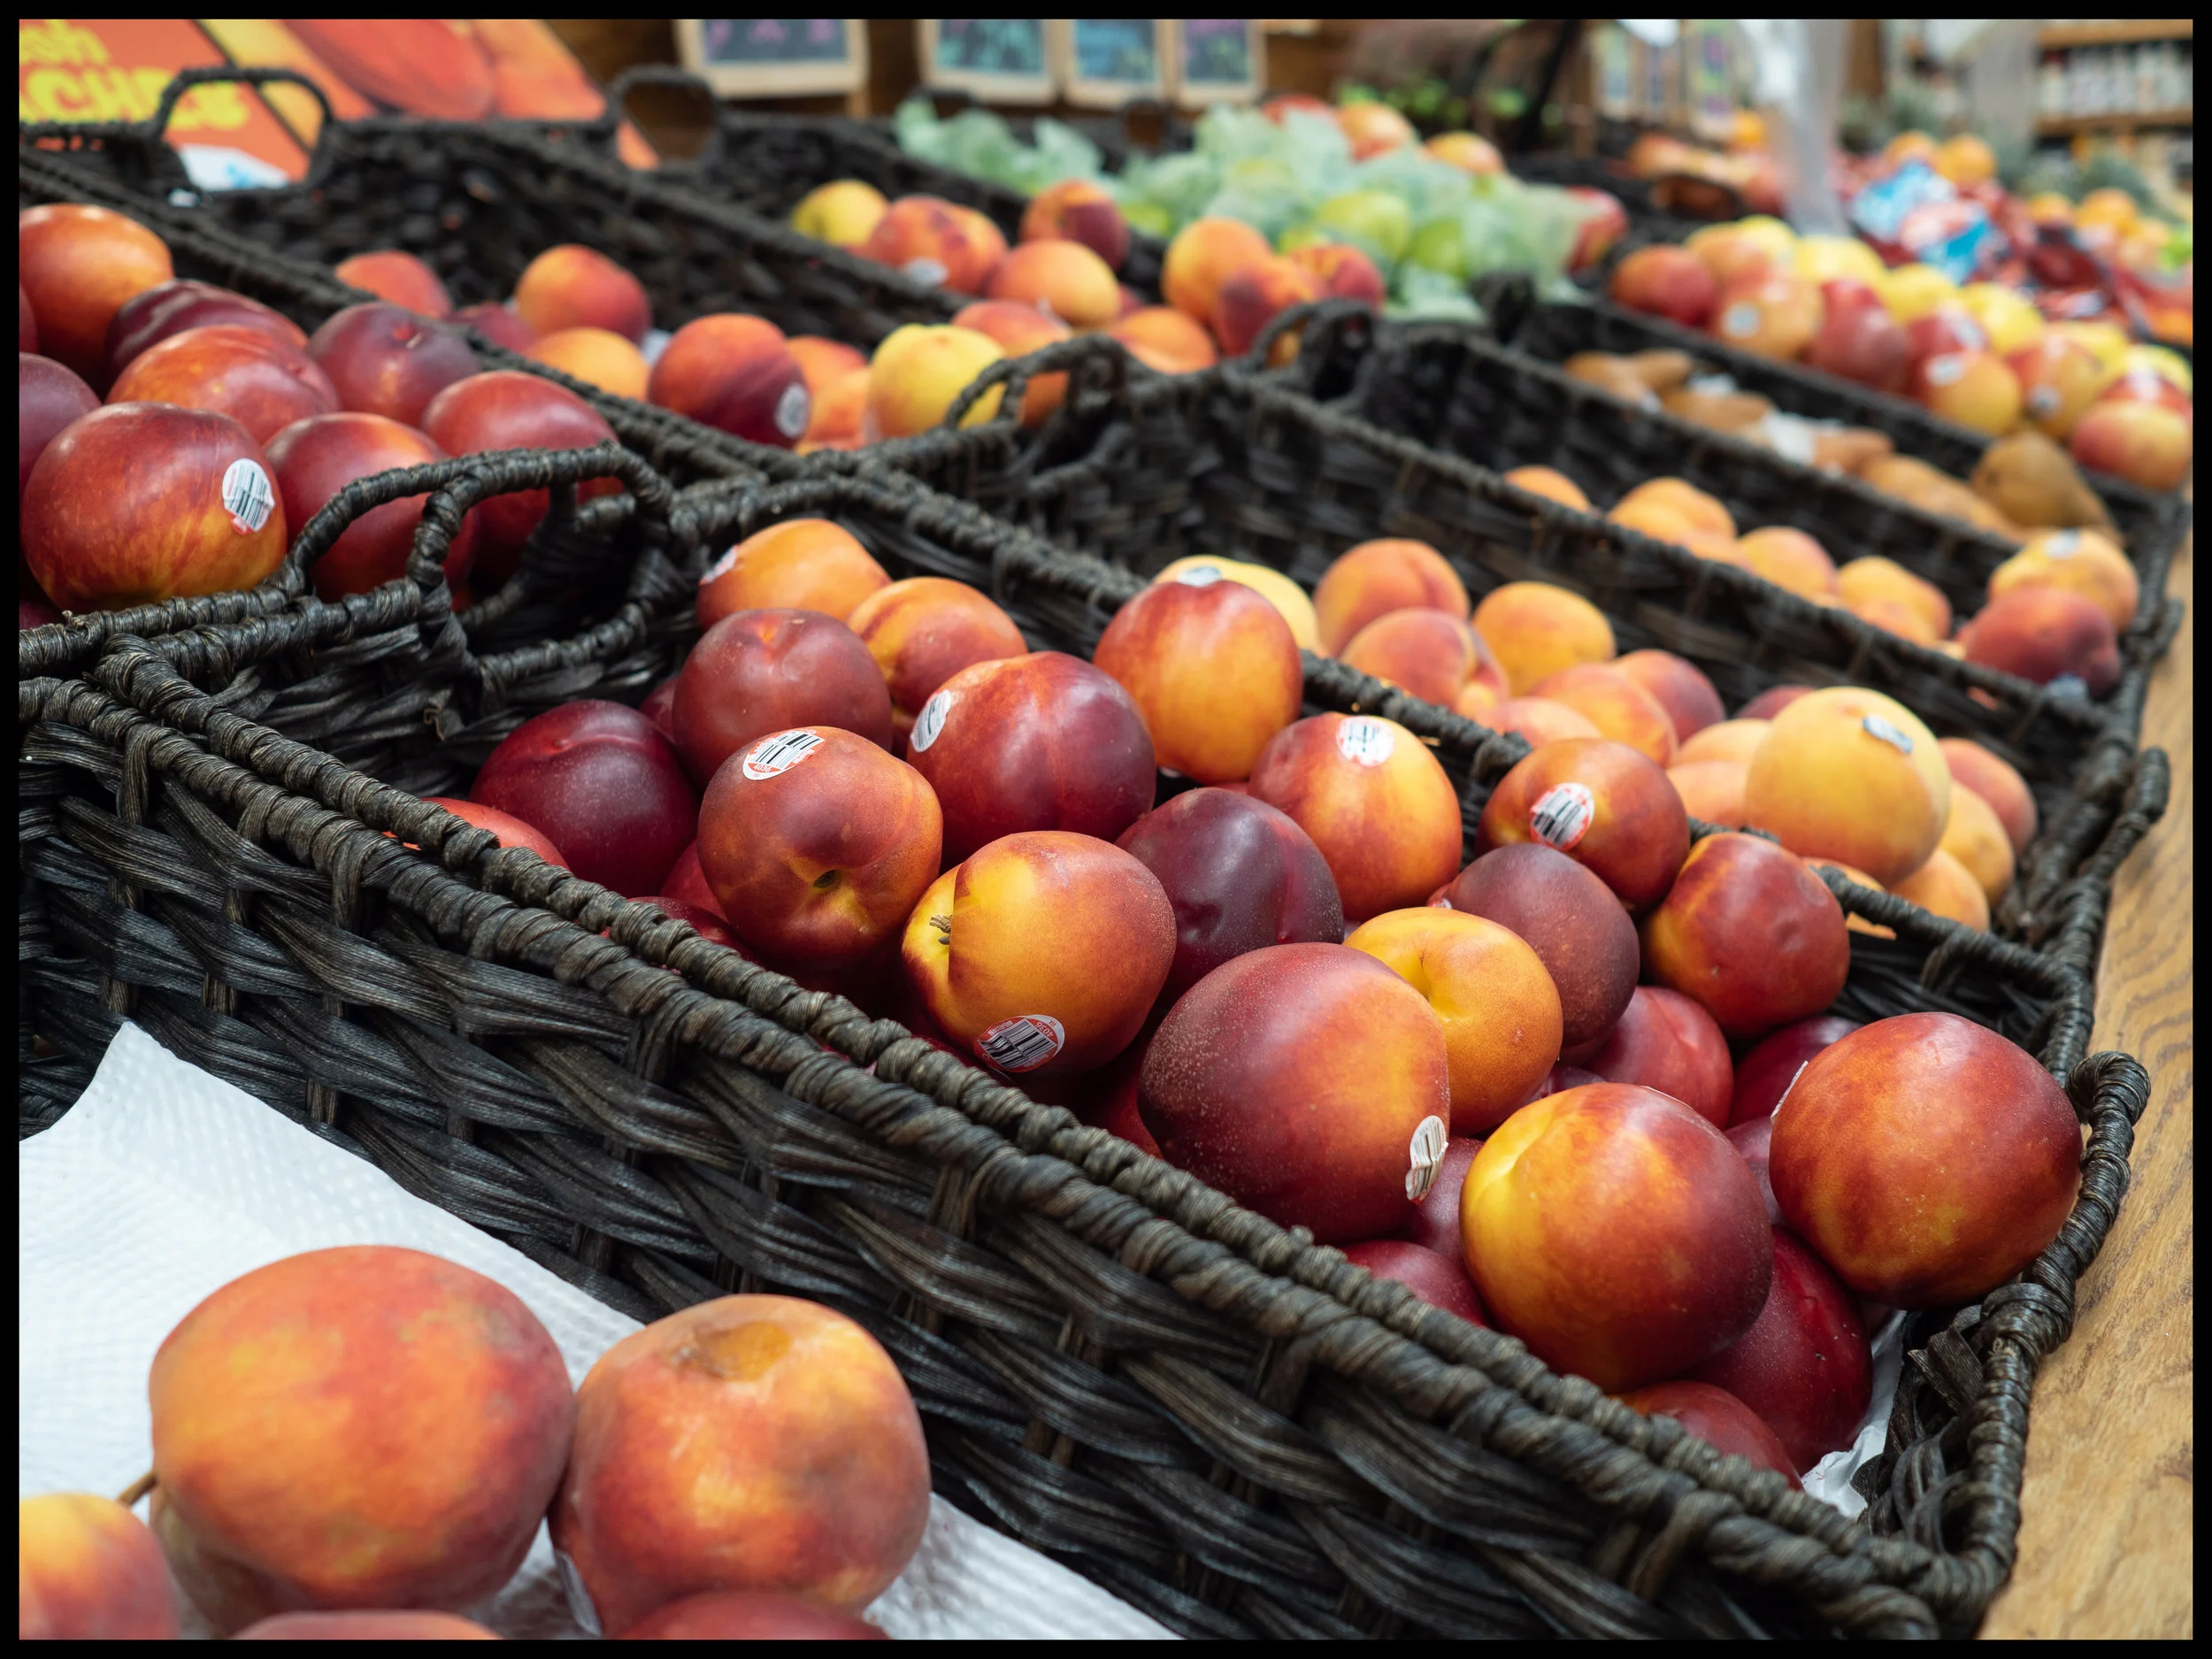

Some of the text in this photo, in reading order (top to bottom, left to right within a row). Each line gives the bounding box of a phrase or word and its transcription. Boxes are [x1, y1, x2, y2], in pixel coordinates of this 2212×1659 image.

[752, 763, 772, 772] 4036
[987, 1019, 1014, 1036] Nectarine
[1035, 1021, 1054, 1037] 4036
